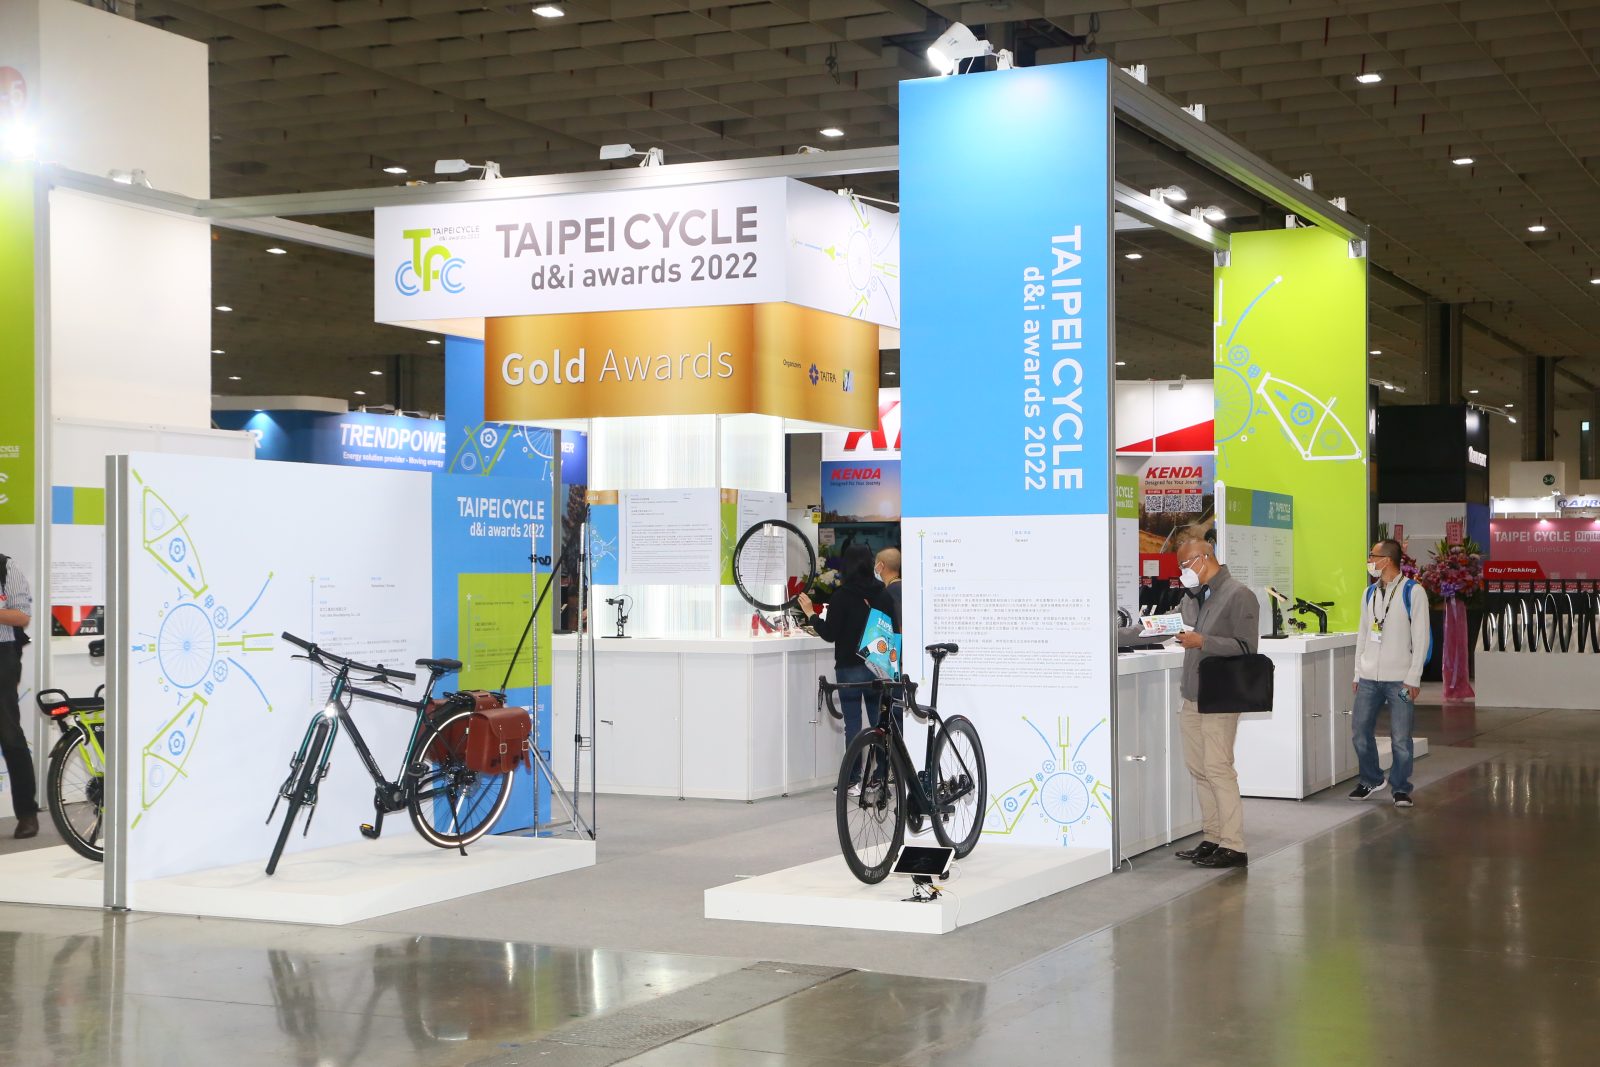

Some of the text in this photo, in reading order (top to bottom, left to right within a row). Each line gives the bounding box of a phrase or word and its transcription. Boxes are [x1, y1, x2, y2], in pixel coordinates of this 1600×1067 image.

[433, 225, 480, 235] TAIPEI CYCLE
[495, 206, 758, 258] TAIPEI CYCLE
[531, 252, 758, 290] d&i awards 2022
[501, 341, 734, 386] Gold Awards
[1051, 225, 1084, 490] TAIPEI CYCLE
[1023, 266, 1047, 490] d&i awards 2022
[831, 467, 881, 480] KENDA
[1145, 466, 1203, 479] KENDA
[457, 496, 545, 520] TAIPEI CYCLE
[470, 521, 487, 537] d&i
[487, 523, 522, 538] awards
[1494, 531, 1530, 542] TAIPEI
[1533, 531, 1571, 542] CYCLE
